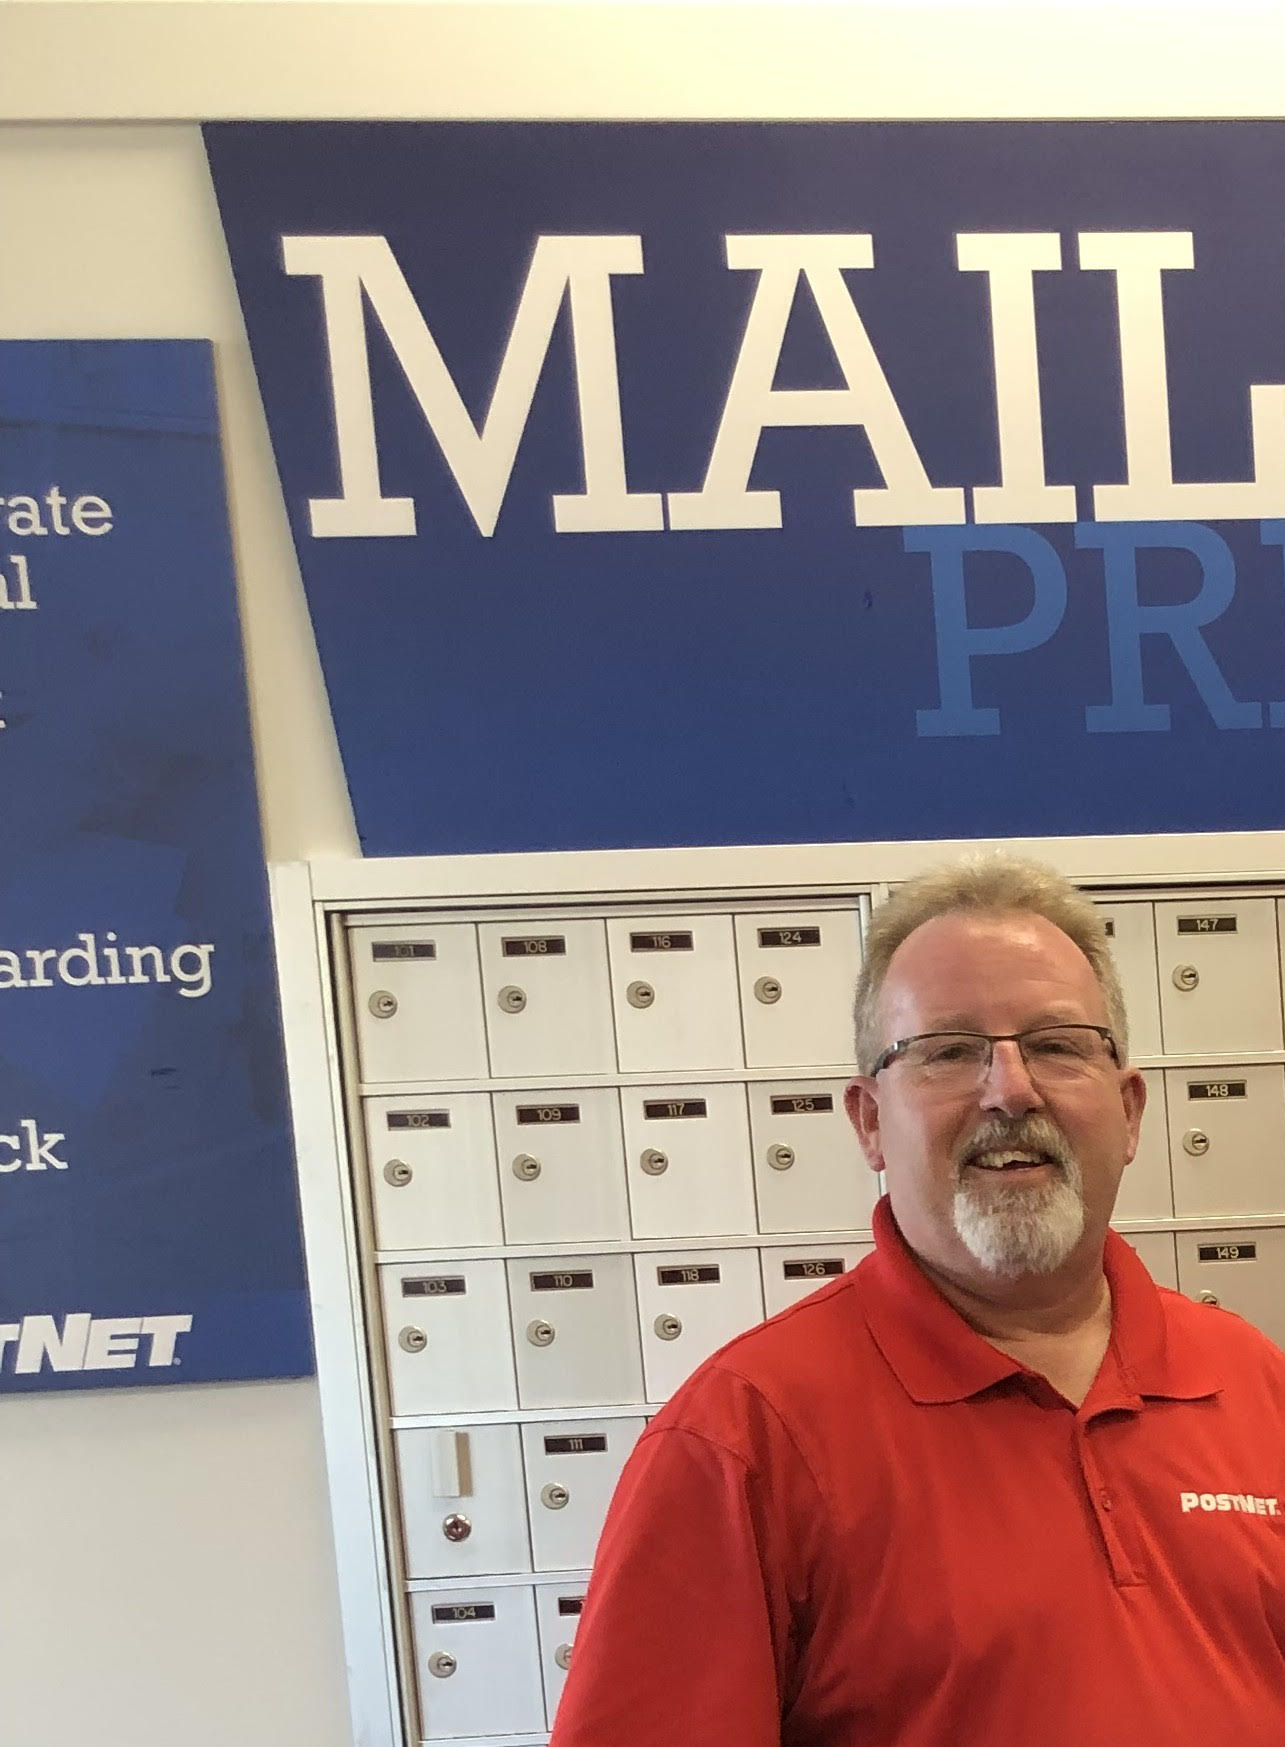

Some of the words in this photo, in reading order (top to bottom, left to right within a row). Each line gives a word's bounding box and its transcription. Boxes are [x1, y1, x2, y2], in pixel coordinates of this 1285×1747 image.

[0, 485, 113, 536] ate
[1196, 919, 1218, 931] 147
[651, 936, 671, 949] 116
[778, 932, 802, 945] 124
[522, 941, 547, 954] 108
[1206, 1085, 1228, 1098] 148
[668, 1103, 686, 1116] 117
[792, 1099, 815, 1112] 125
[407, 1114, 429, 1128] 102
[537, 1109, 562, 1122] 109
[1216, 1246, 1239, 1260] 149
[681, 1269, 700, 1283] 118
[802, 1263, 825, 1276] 126
[554, 1275, 573, 1287] 110
[568, 1439, 583, 1452] 111
[453, 1608, 477, 1619] 104
